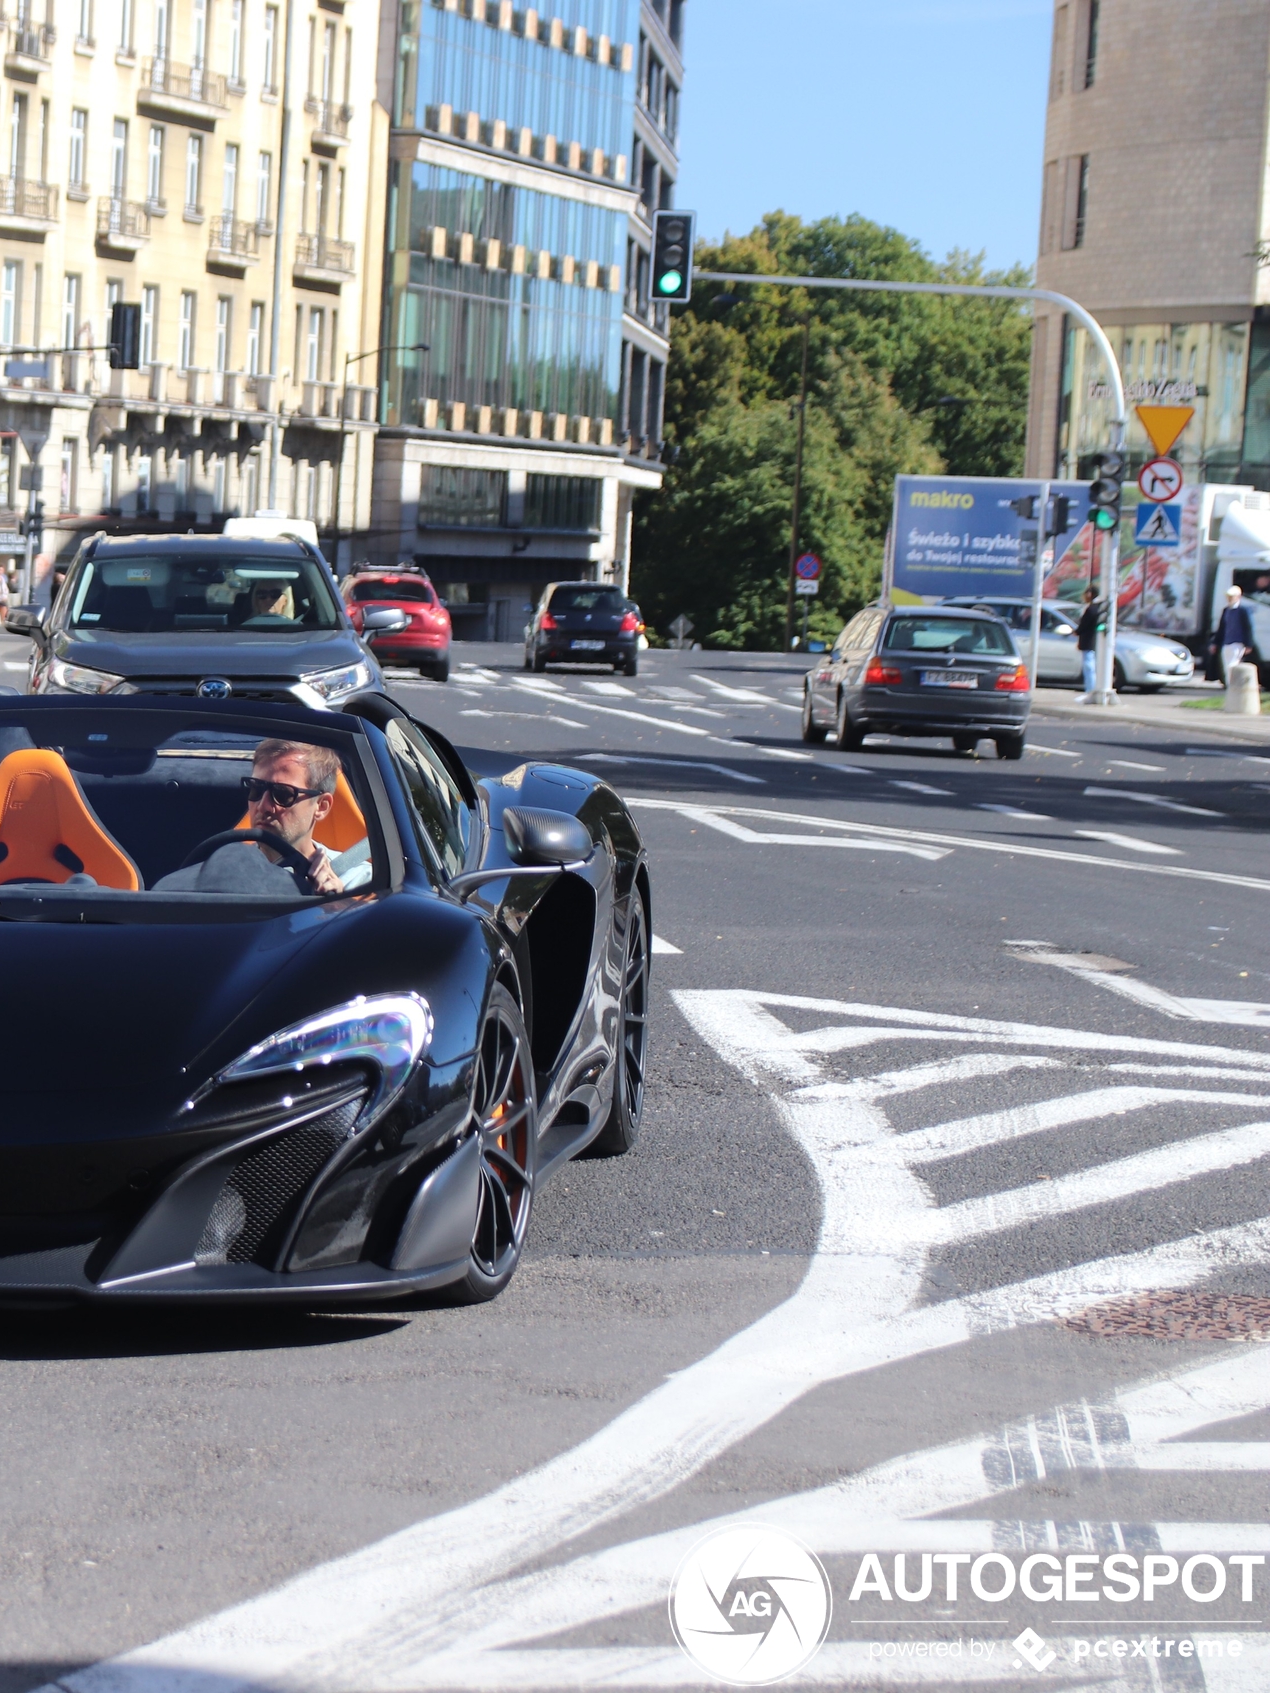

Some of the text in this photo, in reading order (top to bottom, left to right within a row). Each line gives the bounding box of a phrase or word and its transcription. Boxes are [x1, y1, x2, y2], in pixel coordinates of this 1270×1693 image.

[911, 490, 974, 509] makro
[908, 528, 960, 547] Świeżo
[962, 533, 969, 547] i
[906, 549, 922, 562] do
